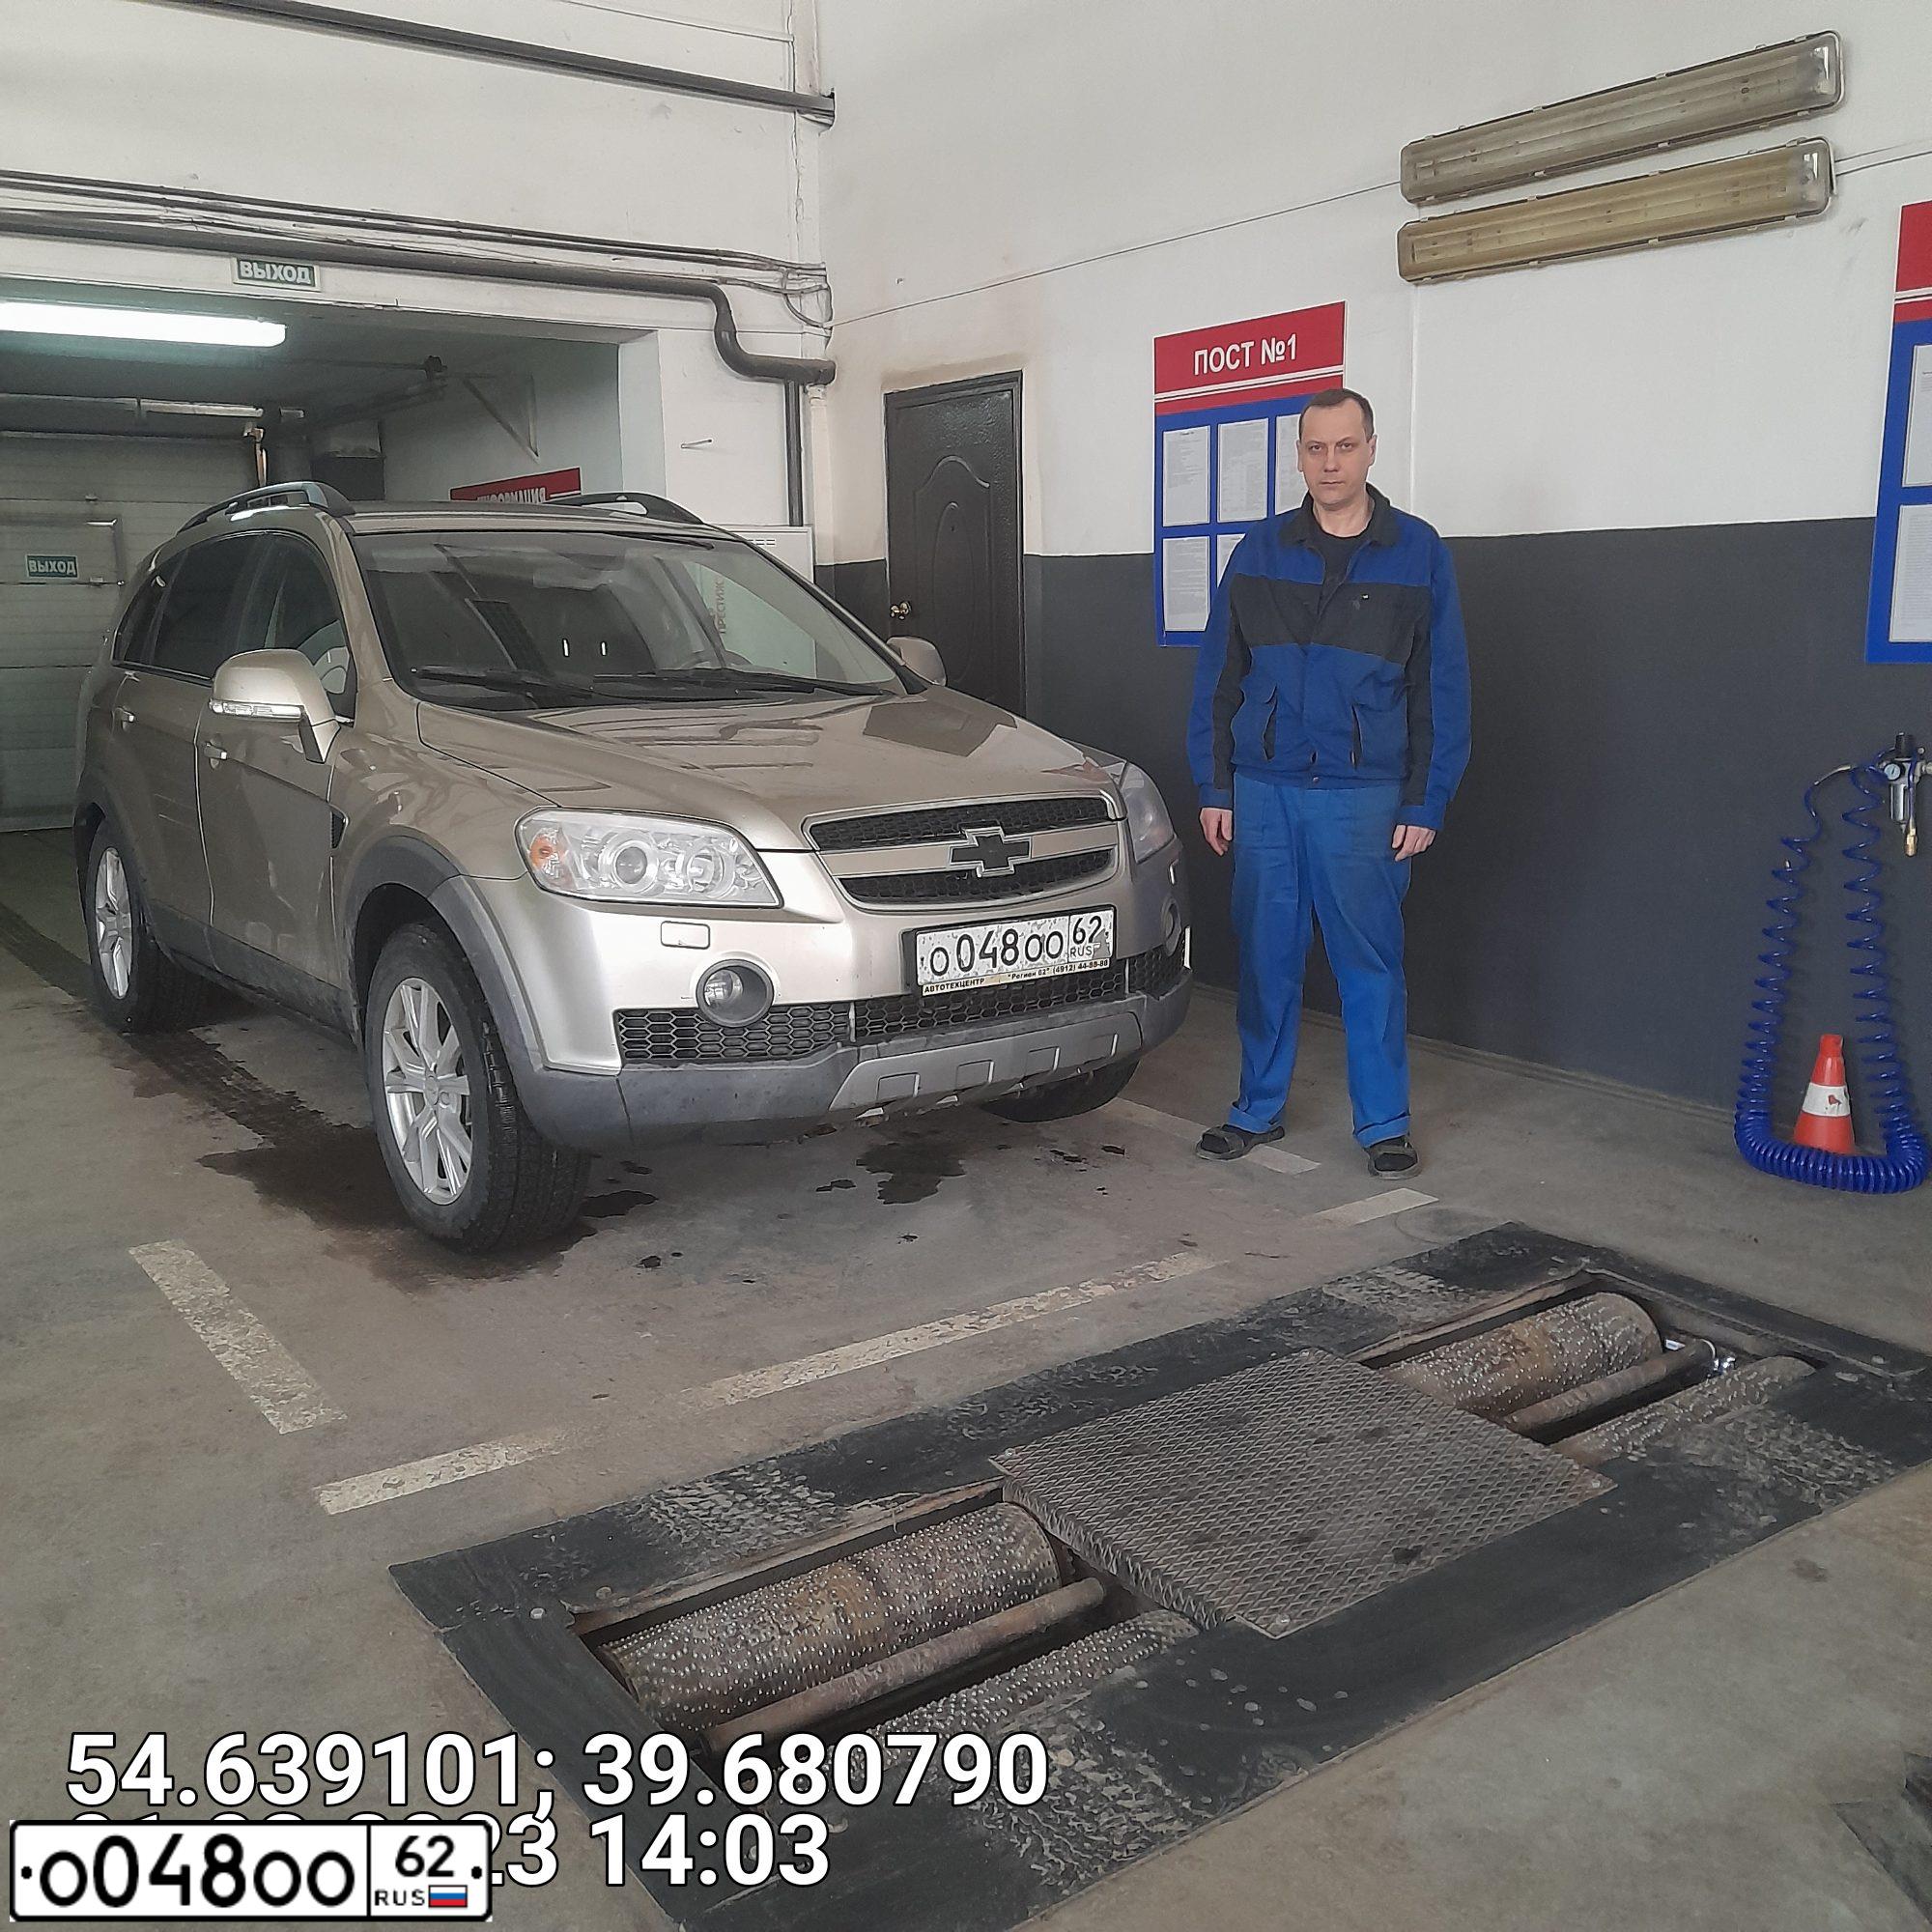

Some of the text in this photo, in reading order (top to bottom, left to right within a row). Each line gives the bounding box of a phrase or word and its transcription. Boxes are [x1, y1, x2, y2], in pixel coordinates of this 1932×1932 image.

[239, 260, 311, 284] ВЫХОД
[1194, 333, 1296, 375] ПОСТ №1
[477, 487, 546, 503] ФОРМАЦИЯ
[28, 559, 76, 576] ВЫХОД
[1072, 915, 1102, 945] 62
[1069, 947, 1093, 958] RUS
[923, 978, 985, 993] АВТОТЕХЦЕНТР
